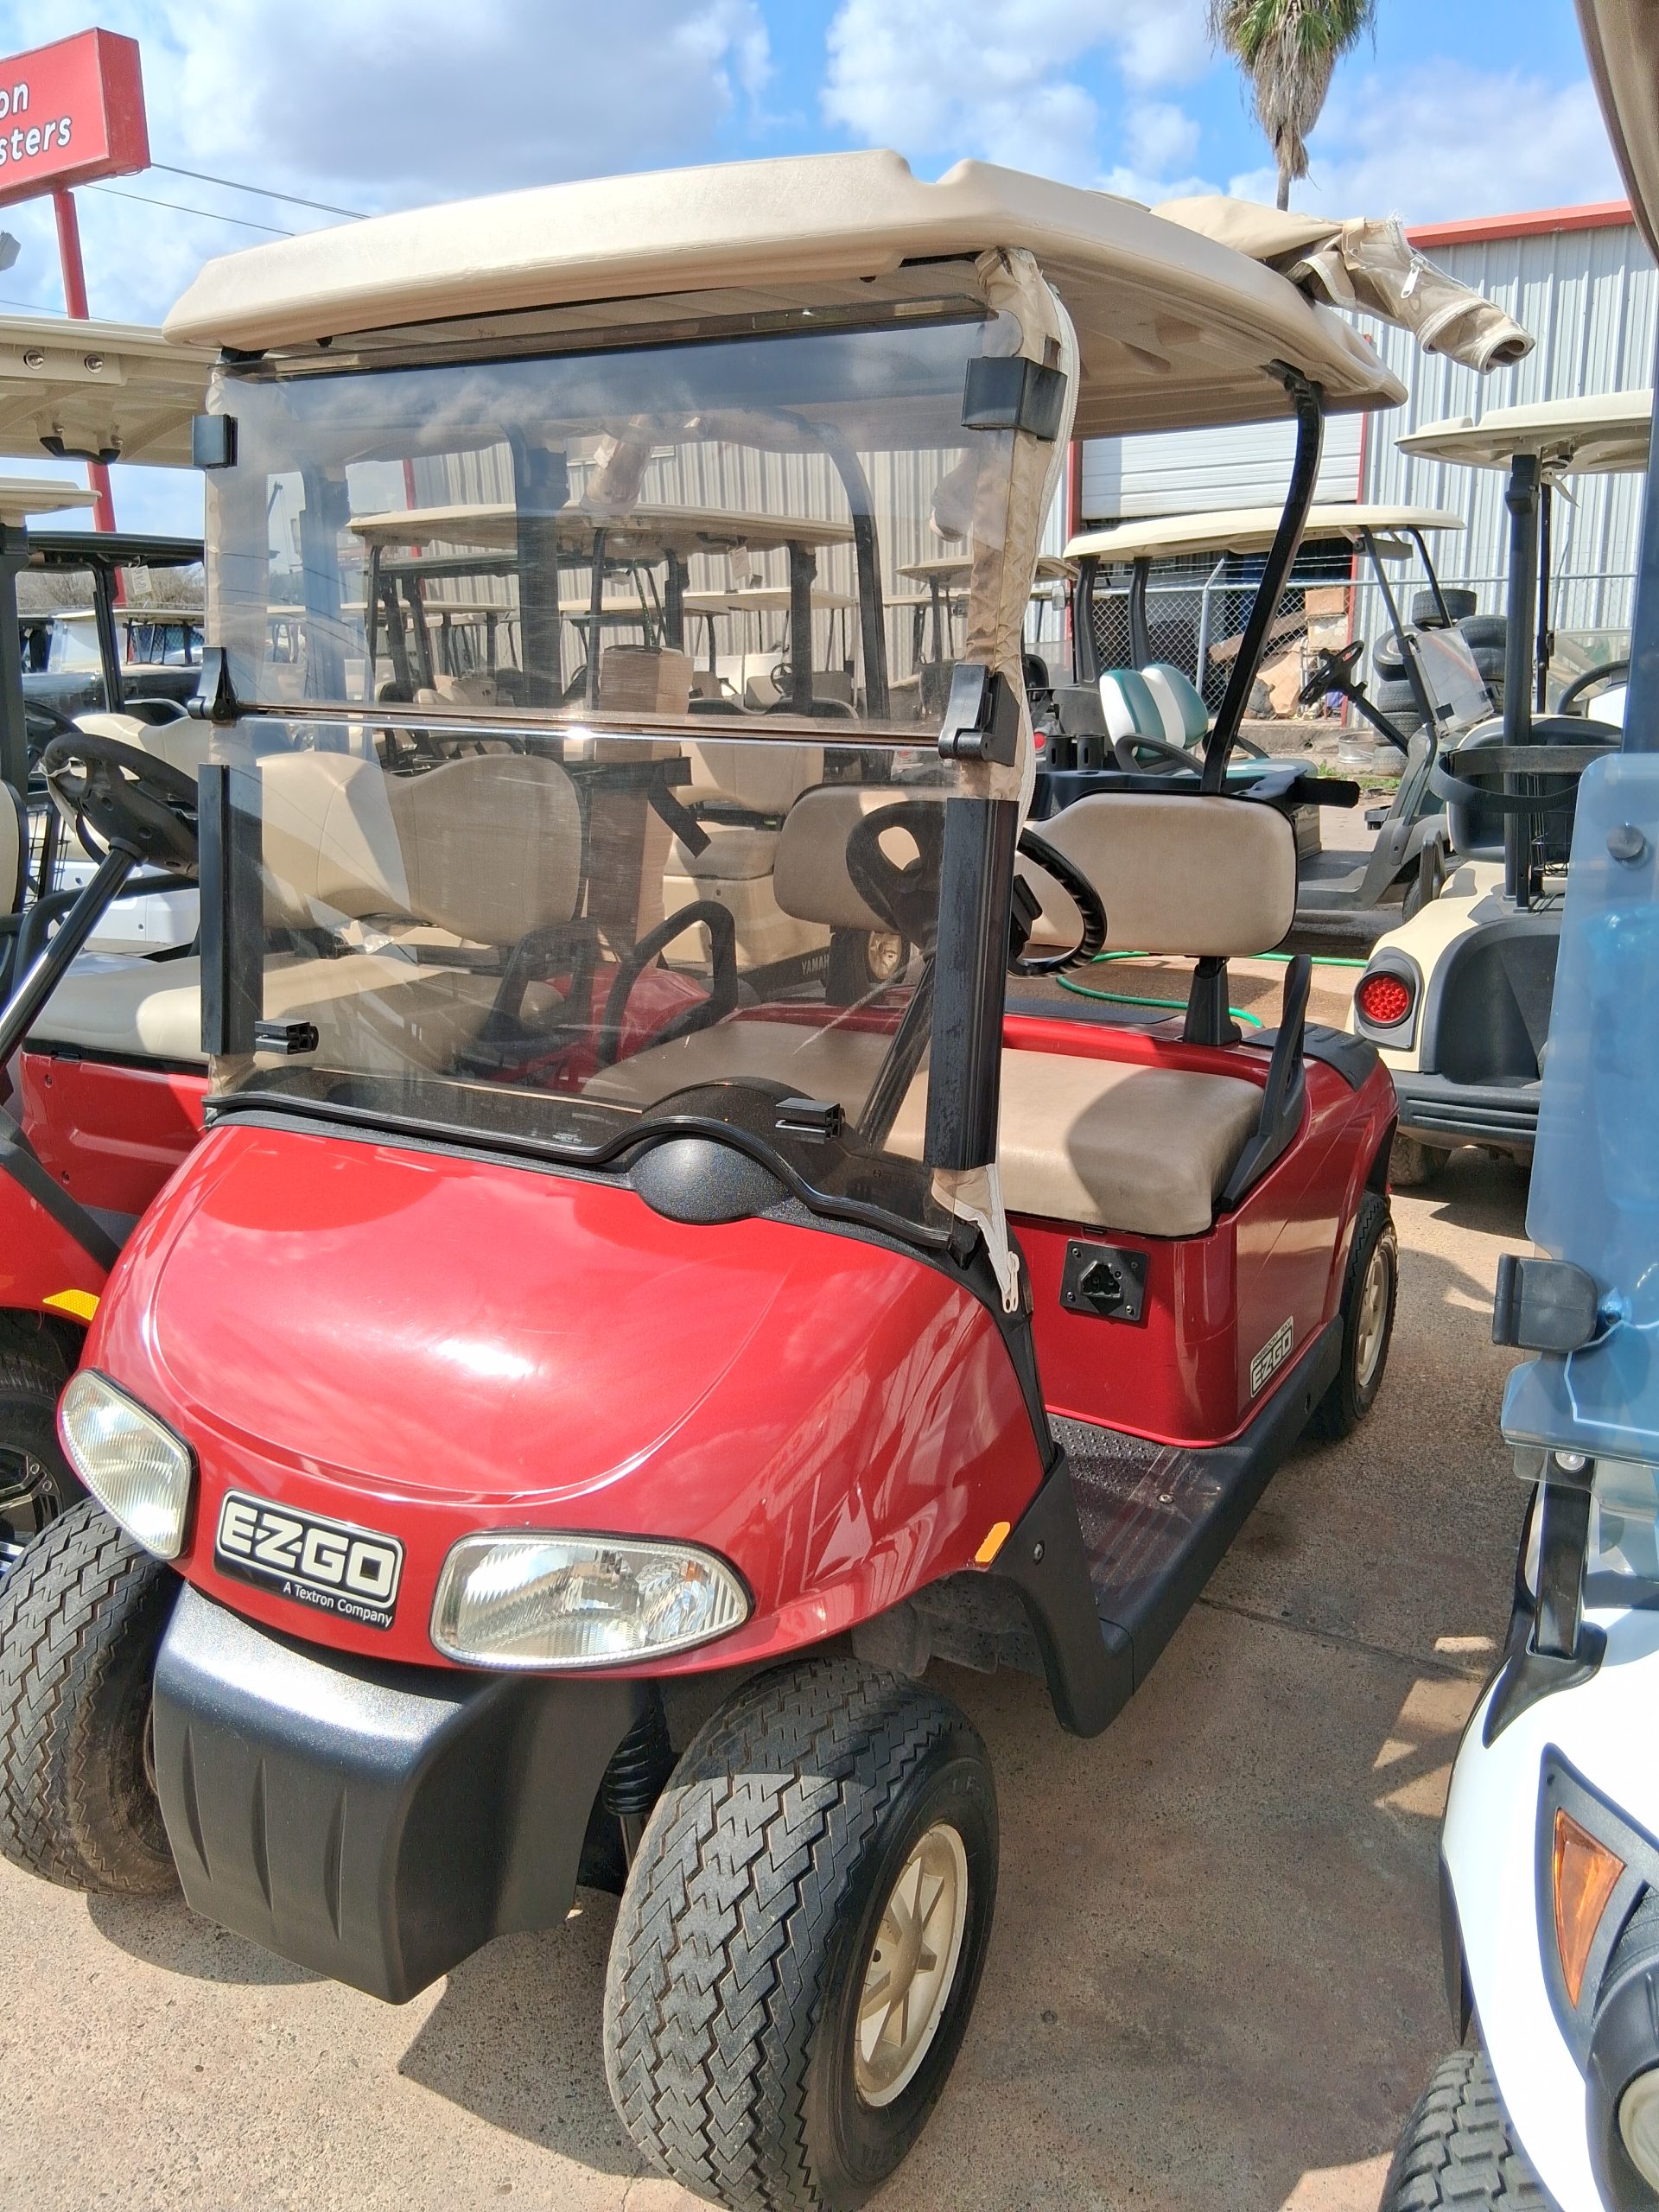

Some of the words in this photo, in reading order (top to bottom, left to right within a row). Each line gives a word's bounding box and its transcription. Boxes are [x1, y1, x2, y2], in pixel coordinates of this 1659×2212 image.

[0, 118, 72, 166] sters
[283, 1581, 292, 1596] A
[295, 1583, 335, 1609] Textron
[337, 1599, 393, 1628] Company
